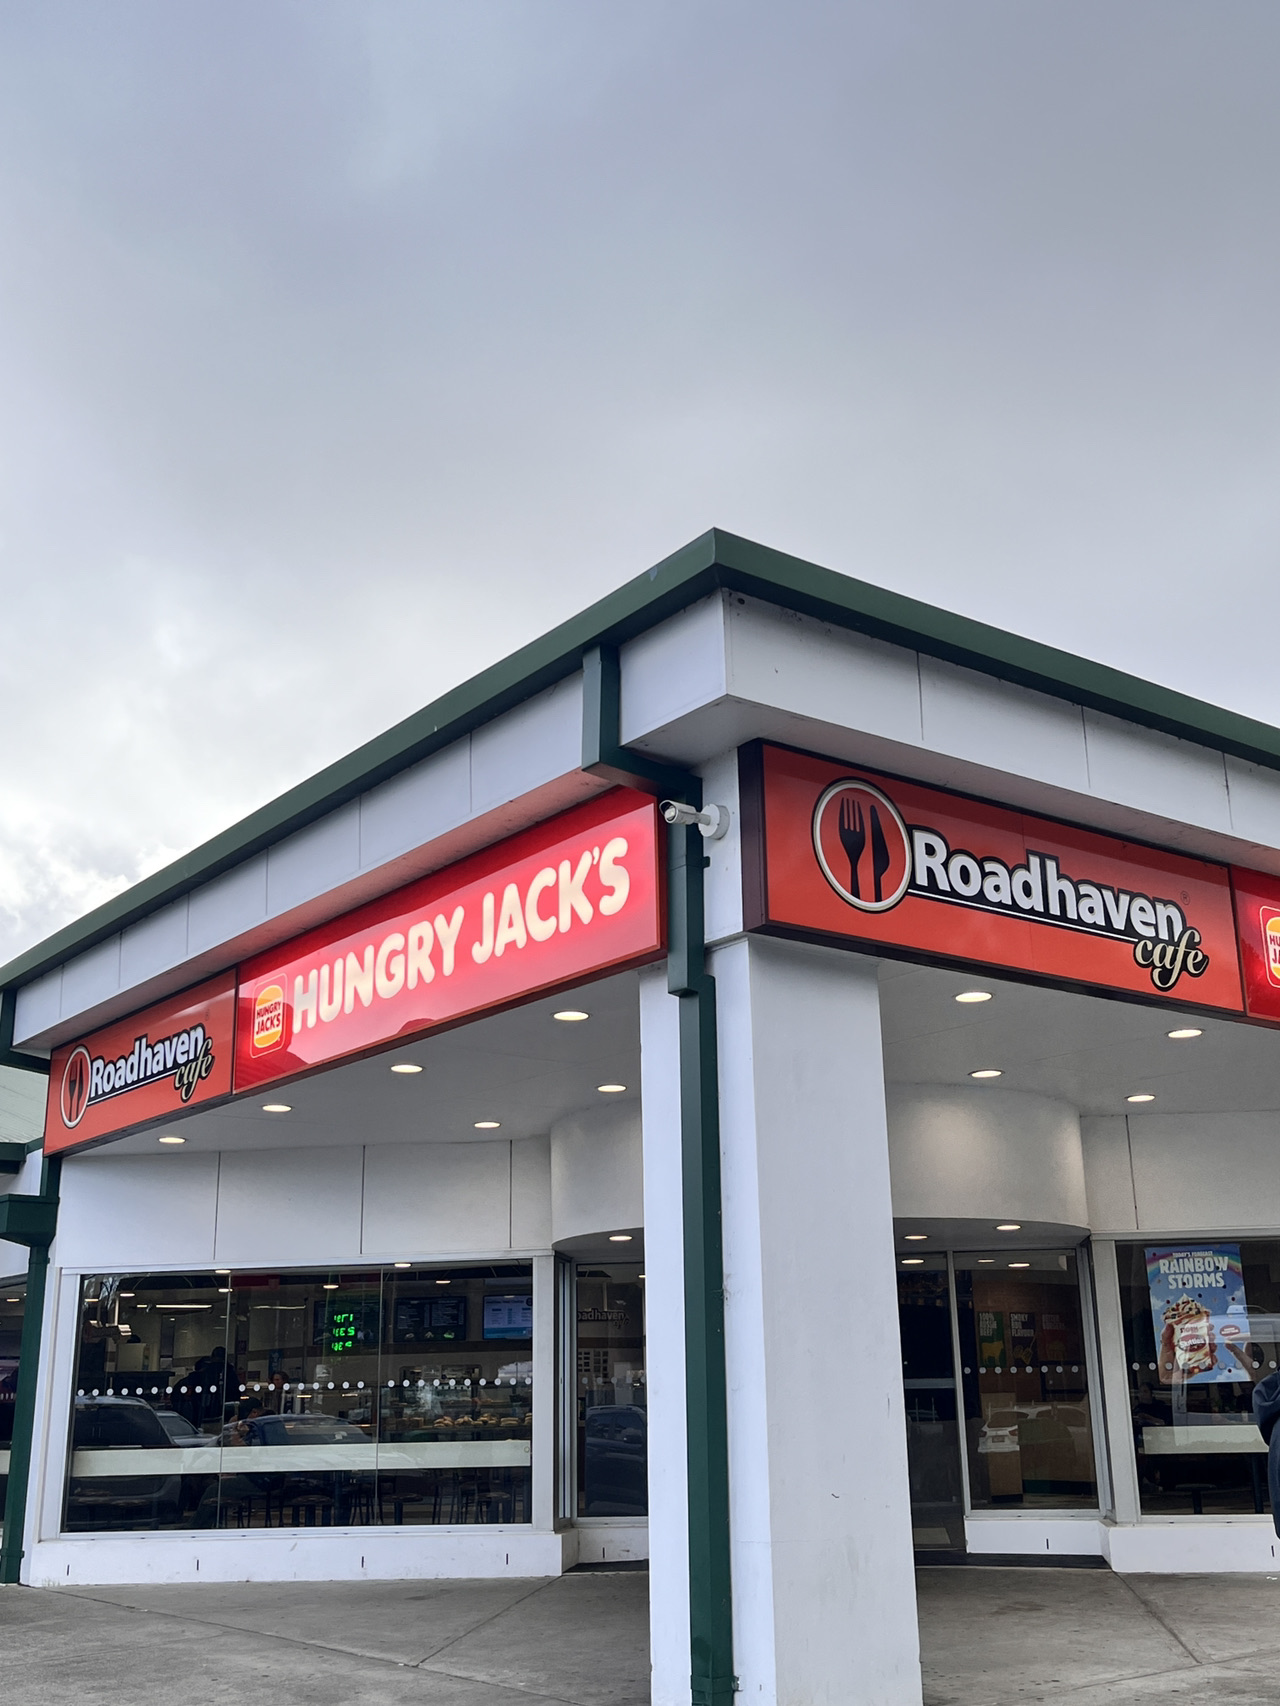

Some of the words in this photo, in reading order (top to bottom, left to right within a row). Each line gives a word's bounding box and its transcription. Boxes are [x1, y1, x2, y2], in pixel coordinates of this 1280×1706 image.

[914, 831, 1183, 941] Roadhaven
[292, 906, 465, 1034] HUNGRY
[471, 837, 631, 965] JACK'S
[1134, 928, 1206, 990] cafe
[256, 1001, 281, 1019] HUNGRY
[91, 1026, 204, 1098] Roadhaven
[174, 1038, 214, 1101] cafe
[1159, 1256, 1229, 1274] RAINBOW
[1168, 1272, 1225, 1290] STORMS
